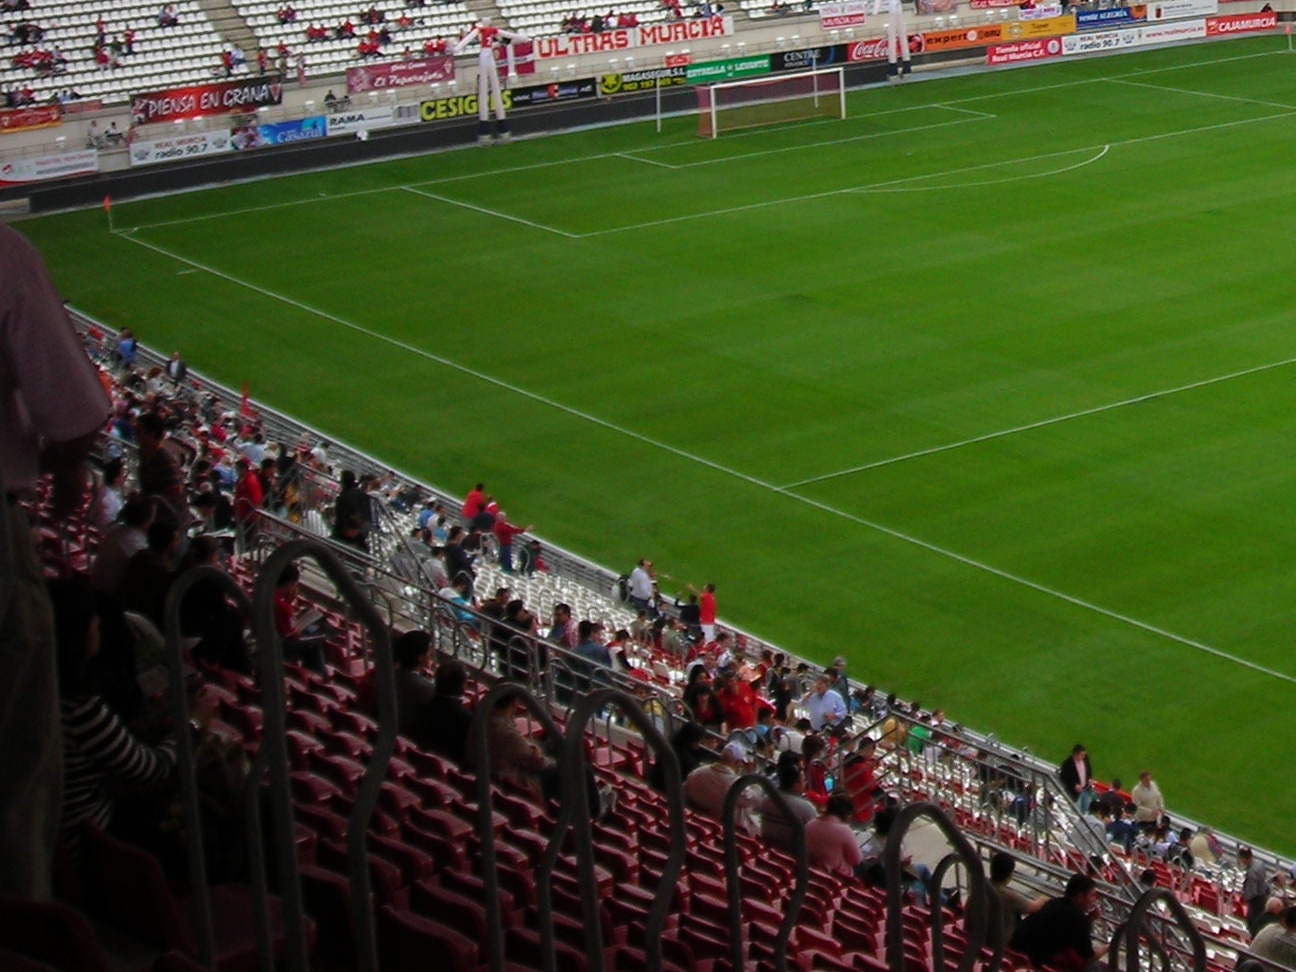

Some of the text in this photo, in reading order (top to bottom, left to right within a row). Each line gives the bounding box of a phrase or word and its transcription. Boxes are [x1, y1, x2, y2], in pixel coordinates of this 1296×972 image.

[538, 16, 725, 57] ULTRAS MURCIA
[1219, 17, 1276, 32] CAJAMURCIA
[149, 84, 269, 117] PIENSA EN GRANA
[330, 114, 365, 126] RAMA
